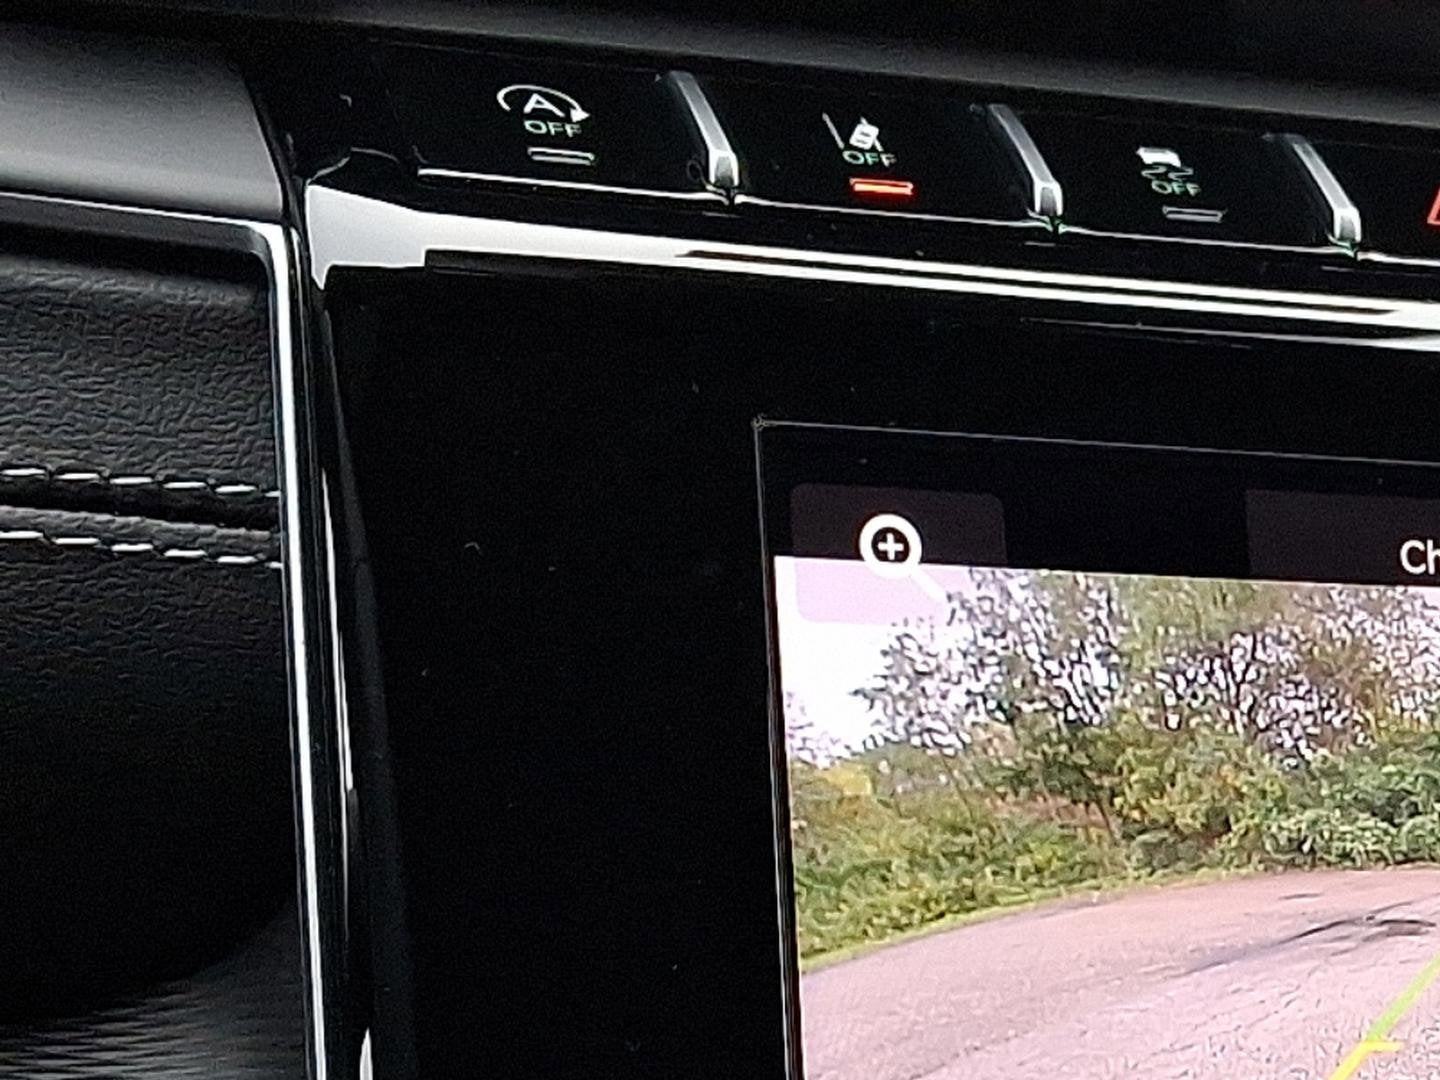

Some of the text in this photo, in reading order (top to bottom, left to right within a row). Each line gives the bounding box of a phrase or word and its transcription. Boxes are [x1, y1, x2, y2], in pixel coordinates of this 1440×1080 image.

[523, 119, 582, 138] OFF
[842, 150, 896, 167] OFF
[1151, 179, 1201, 196] OFF
